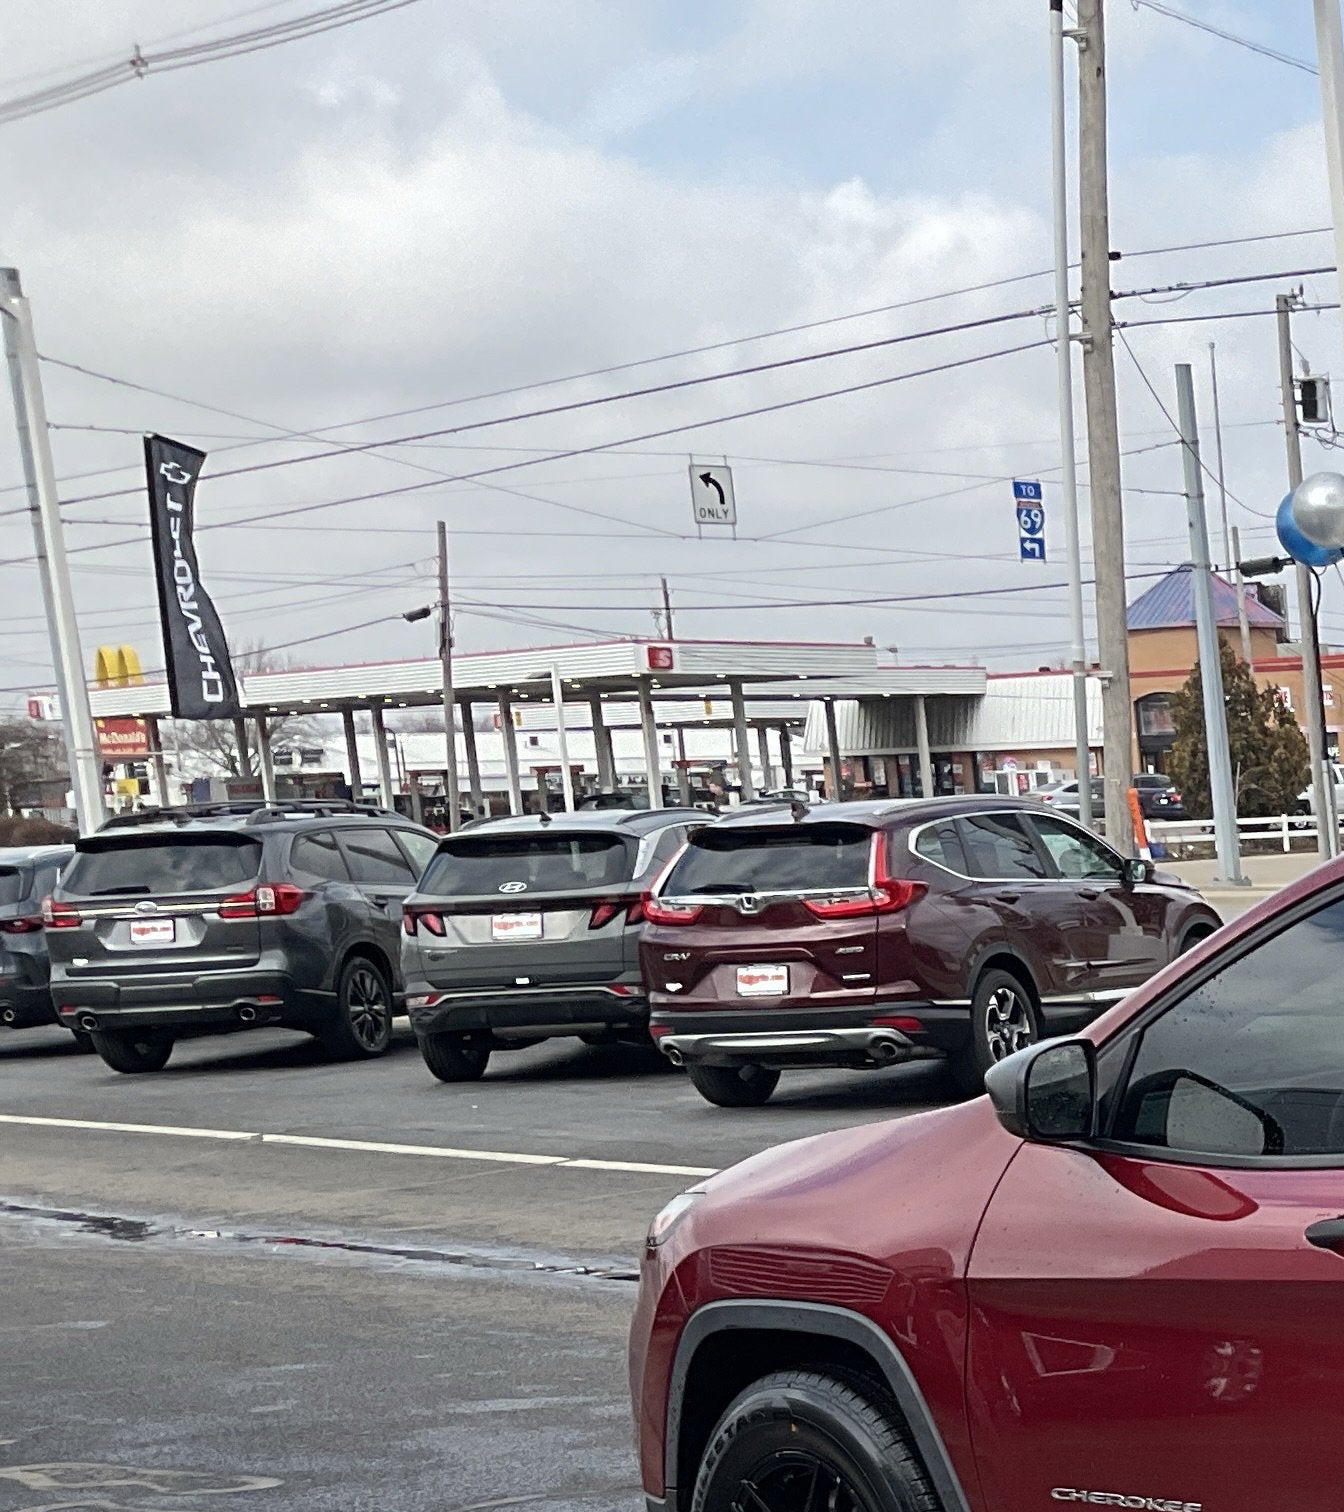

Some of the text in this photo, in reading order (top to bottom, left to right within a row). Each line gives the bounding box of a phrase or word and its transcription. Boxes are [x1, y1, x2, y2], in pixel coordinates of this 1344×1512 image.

[1020, 485, 1035, 497] TO
[699, 507, 729, 519] ONLY
[1020, 509, 1042, 529] 69
